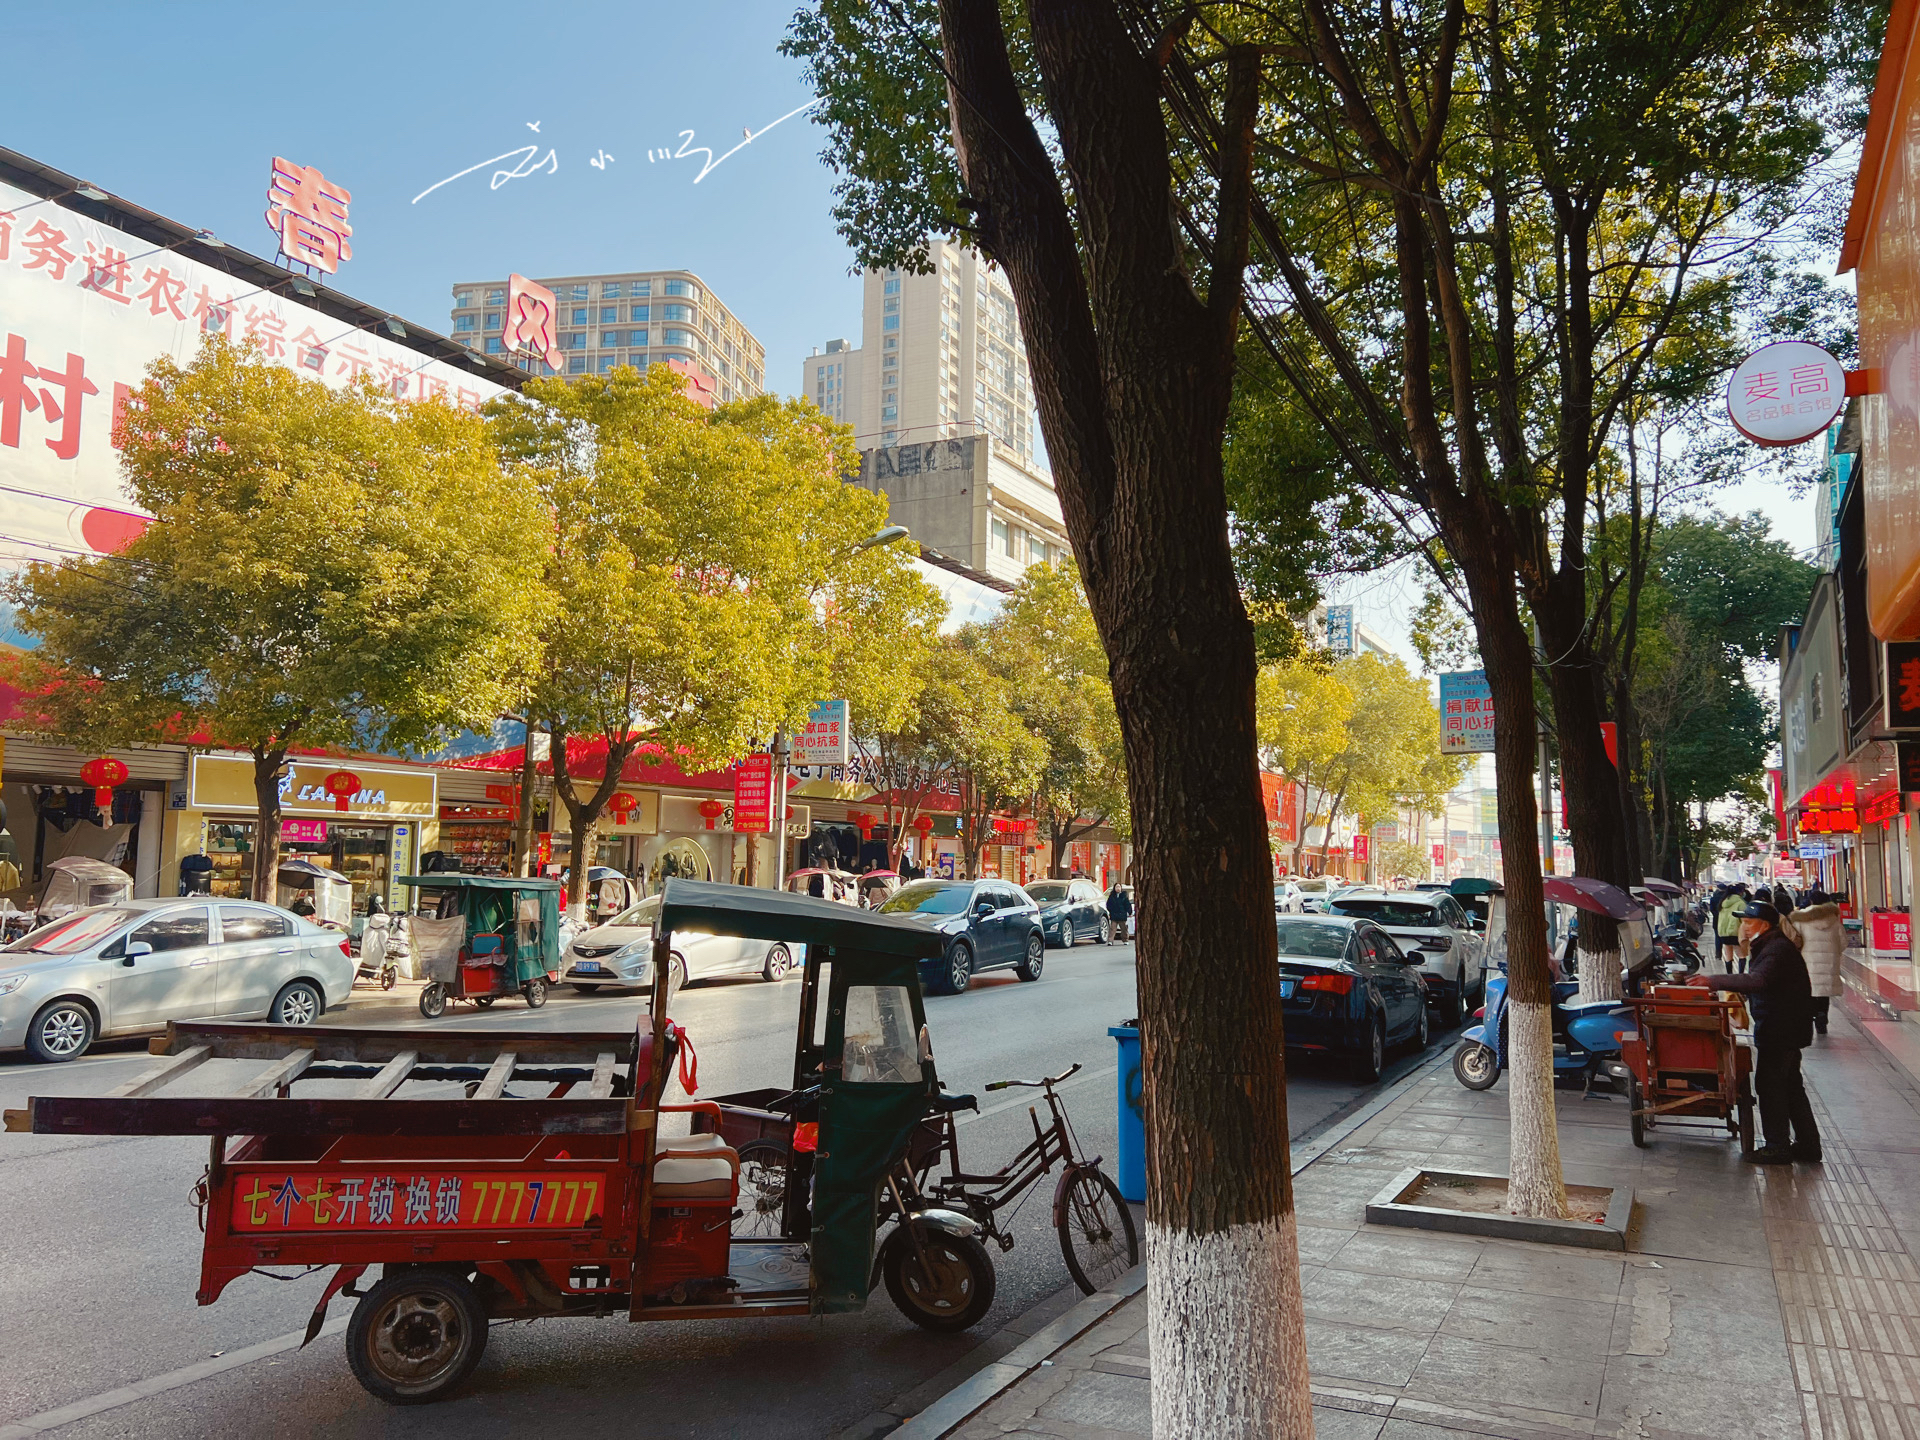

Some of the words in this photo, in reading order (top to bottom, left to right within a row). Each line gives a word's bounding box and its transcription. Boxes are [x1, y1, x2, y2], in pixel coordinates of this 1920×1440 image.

[265, 156, 352, 275] 春
[502, 272, 563, 371] 风
[1743, 362, 1829, 406] 麦高
[1746, 397, 1832, 423] 名品集合馆
[794, 735, 840, 748] 同心抗疫
[802, 721, 840, 734] 献血浆
[472, 1180, 598, 1225] 7777777
